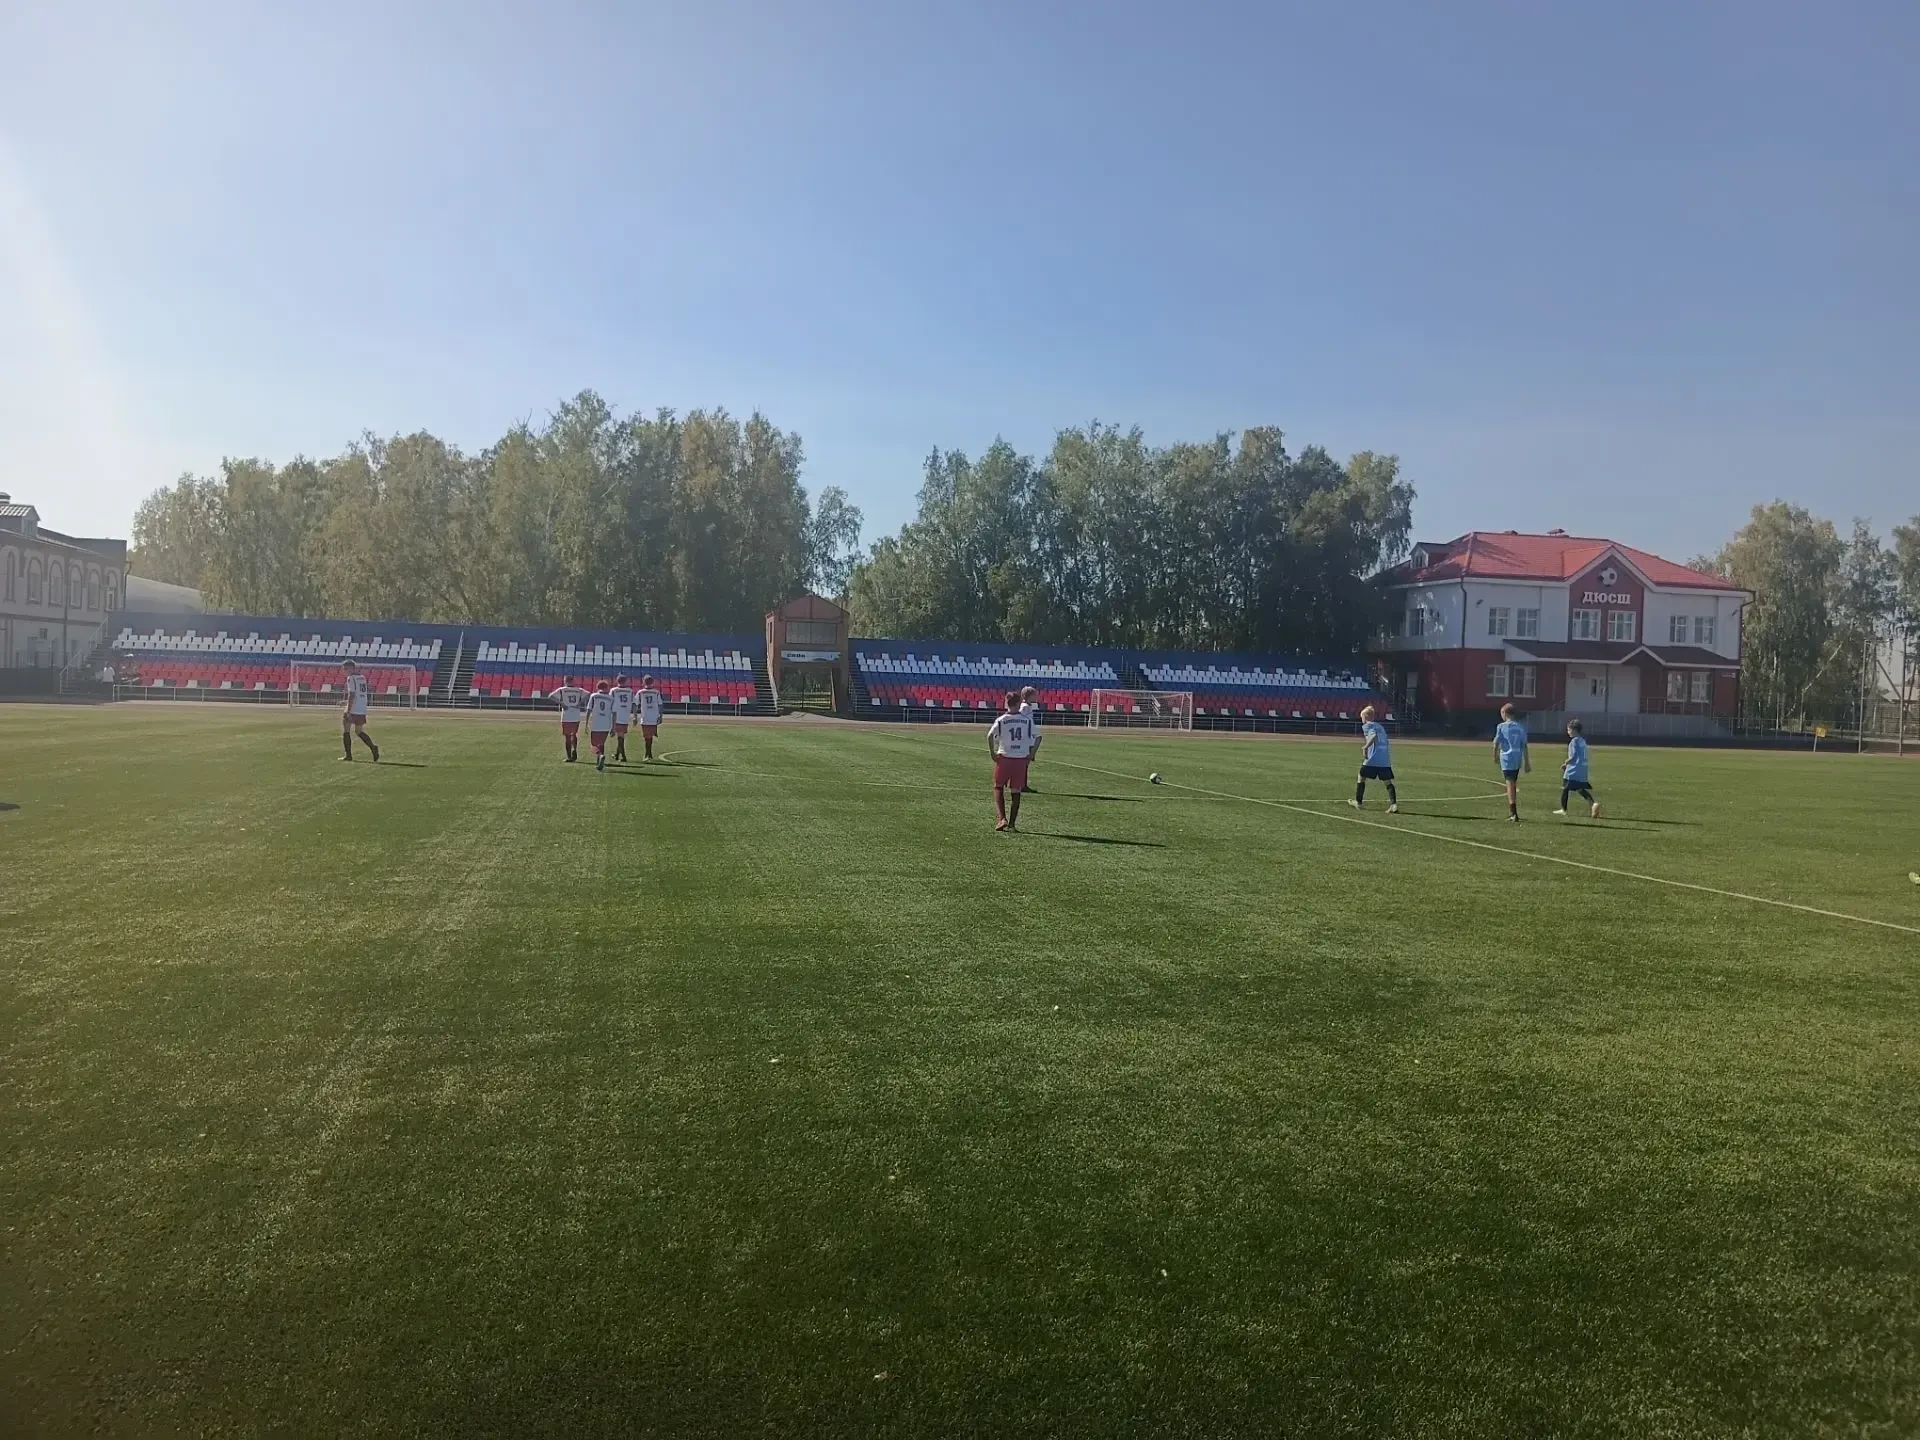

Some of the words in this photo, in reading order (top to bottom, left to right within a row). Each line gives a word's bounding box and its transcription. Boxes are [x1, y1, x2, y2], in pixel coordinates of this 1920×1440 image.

[1582, 591, 1632, 605] ДЮСШ
[568, 695, 577, 703] 13
[599, 701, 606, 711] 9
[1008, 727, 1022, 741] 14
